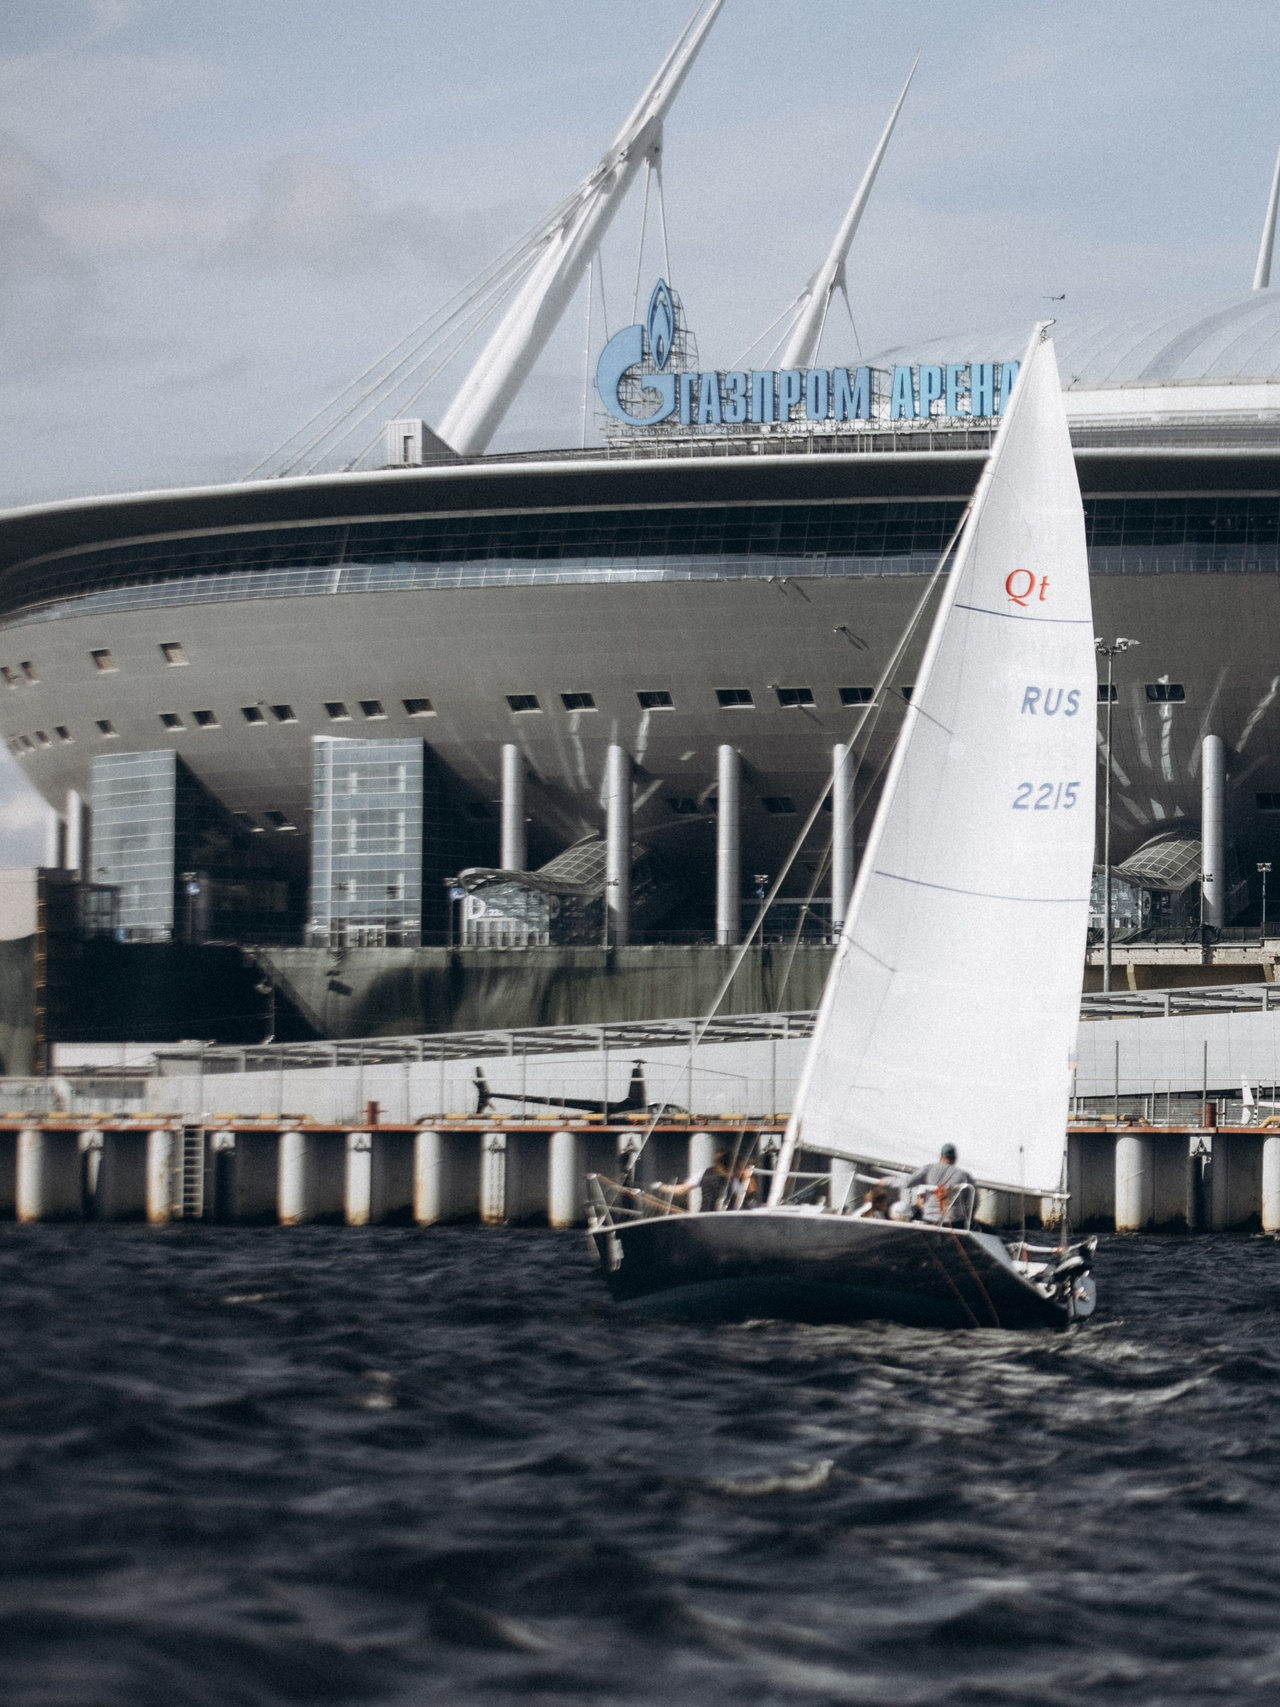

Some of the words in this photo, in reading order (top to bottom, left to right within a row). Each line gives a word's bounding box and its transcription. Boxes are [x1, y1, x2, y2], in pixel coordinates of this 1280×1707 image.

[680, 367, 871, 425] ГАЗПРОМ
[1005, 569, 1050, 607] Qt
[1021, 686, 1081, 717] RUS
[1012, 781, 1081, 810] 2215
